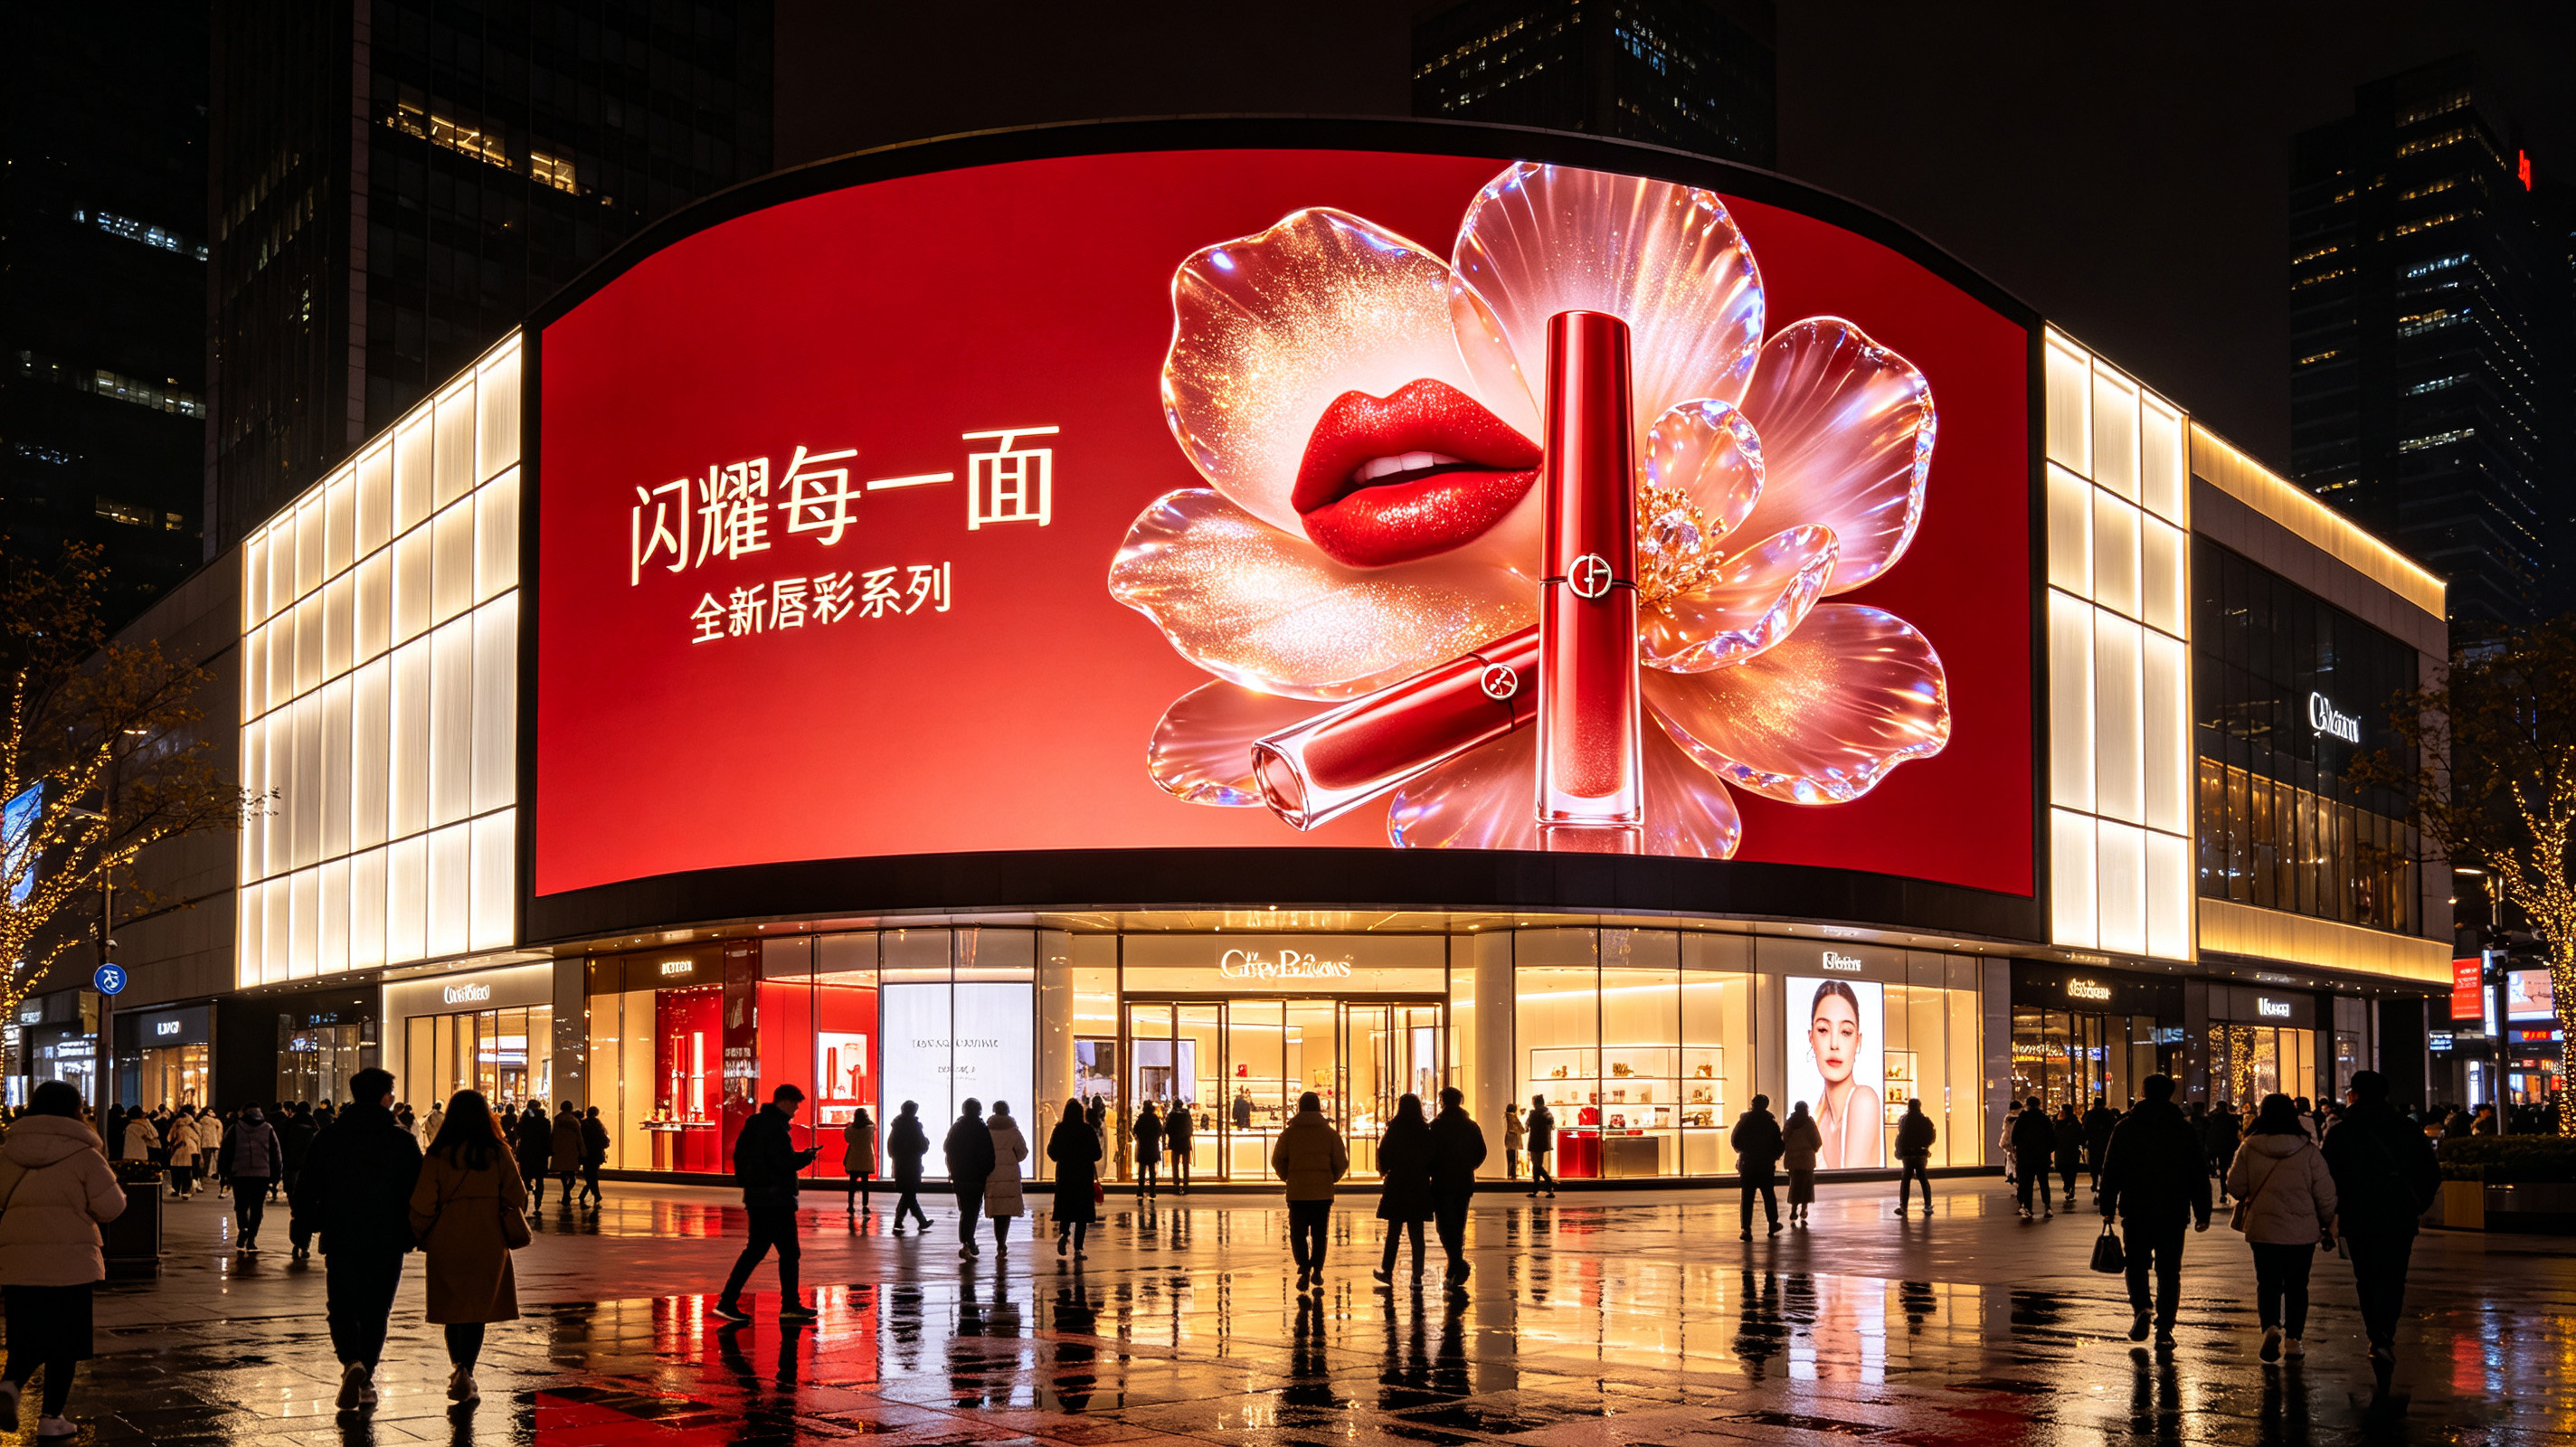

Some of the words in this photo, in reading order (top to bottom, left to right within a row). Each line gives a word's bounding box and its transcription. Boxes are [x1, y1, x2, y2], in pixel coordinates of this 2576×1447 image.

[631, 425, 1060, 587] 闪耀每一面
[690, 561, 951, 644] 全新唇彩系列
